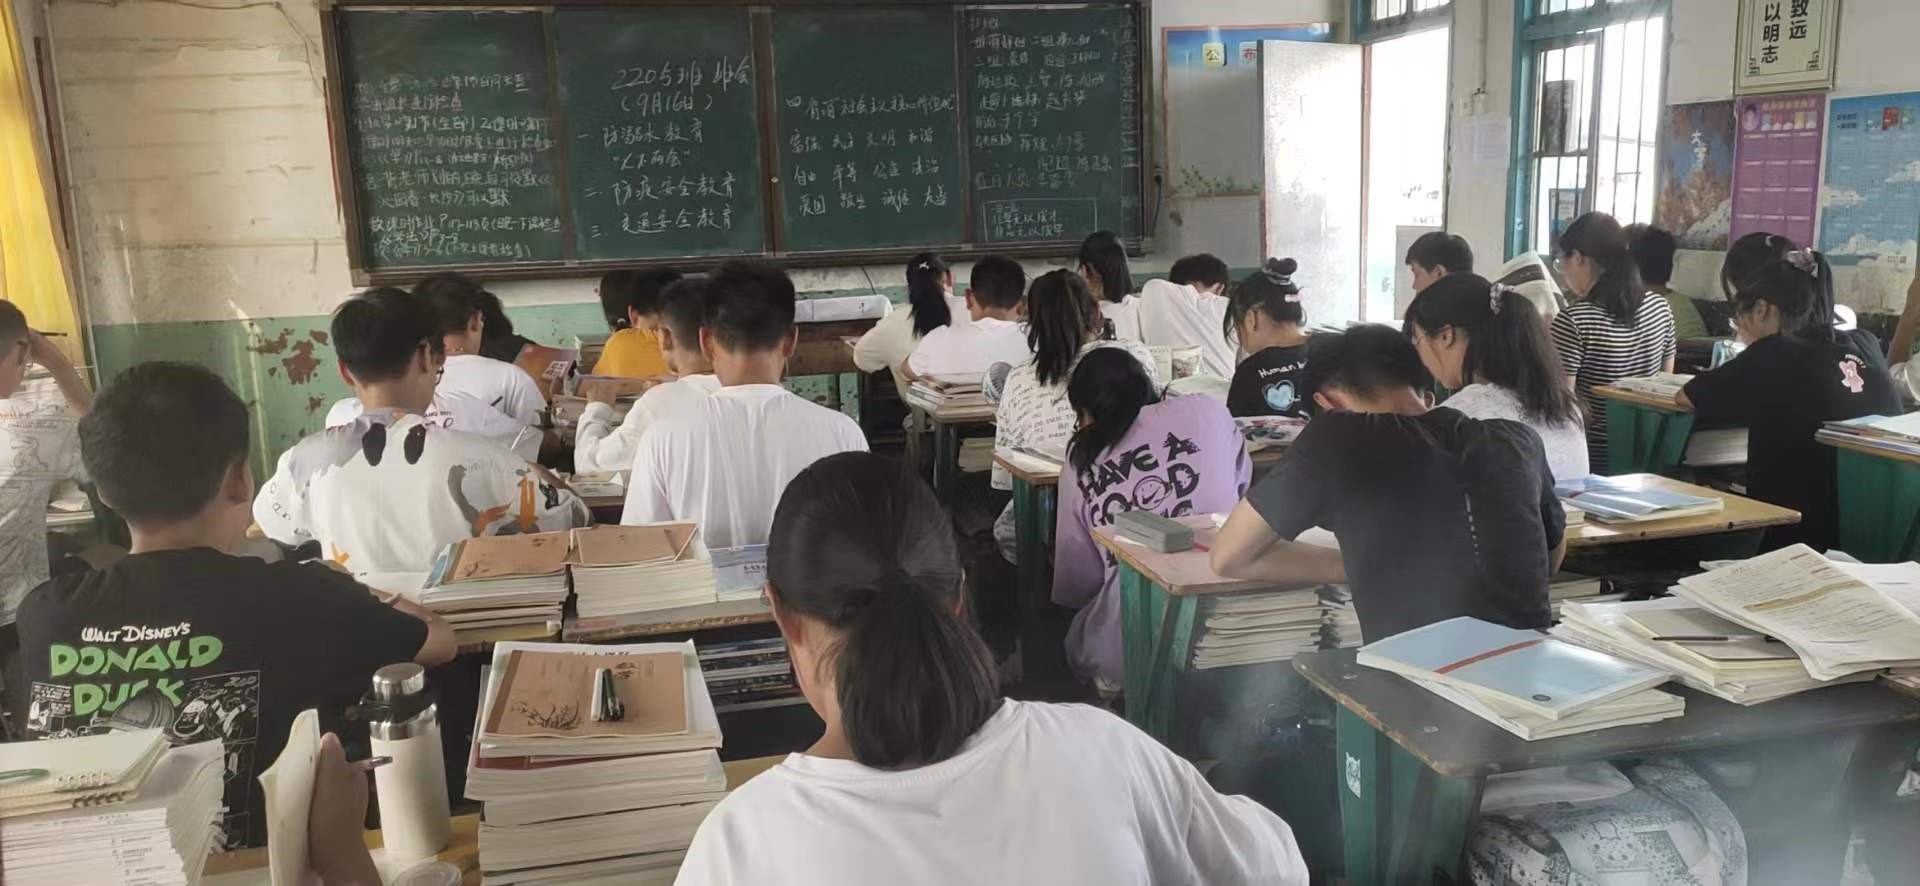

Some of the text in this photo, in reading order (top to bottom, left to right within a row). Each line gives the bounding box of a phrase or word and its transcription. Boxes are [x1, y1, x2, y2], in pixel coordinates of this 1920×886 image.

[908, 126, 935, 145] 和谐
[794, 164, 817, 185] 自由
[832, 160, 857, 189] 平等
[1077, 431, 1200, 505] HAVE A
[82, 625, 120, 643] WALT
[51, 635, 224, 677] DONALD
